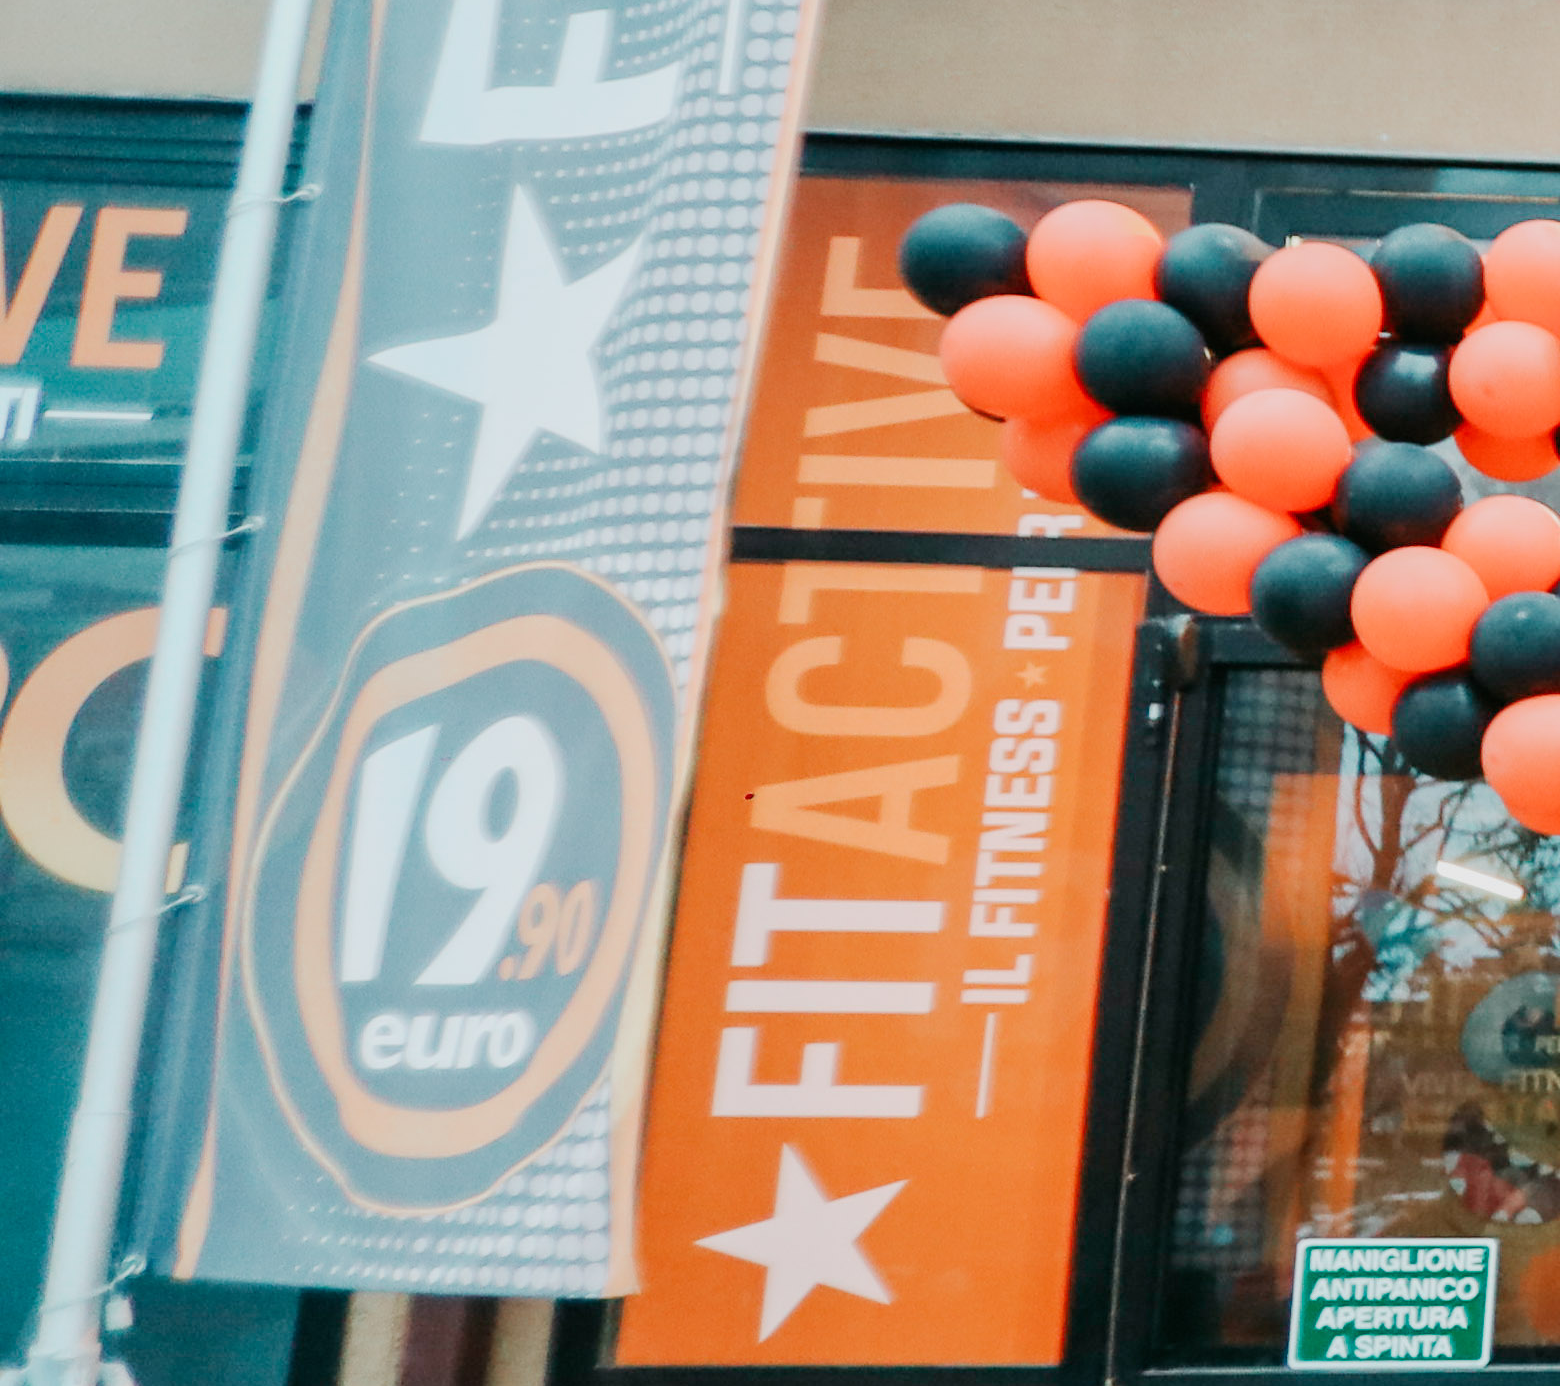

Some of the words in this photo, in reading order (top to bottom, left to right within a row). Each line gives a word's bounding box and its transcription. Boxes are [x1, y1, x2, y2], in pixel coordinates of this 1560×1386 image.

[968, 699, 1062, 938] FITNESS
[961, 953, 1034, 1004] IL
[360, 1010, 534, 1071] euro
[1309, 1248, 1486, 1272] MANIGLIONE
[1309, 1277, 1480, 1301] ANTIPANICO
[1315, 1305, 1469, 1330] APERTURA
[1325, 1335, 1348, 1359] A
[1353, 1334, 1453, 1359] SPINTA
